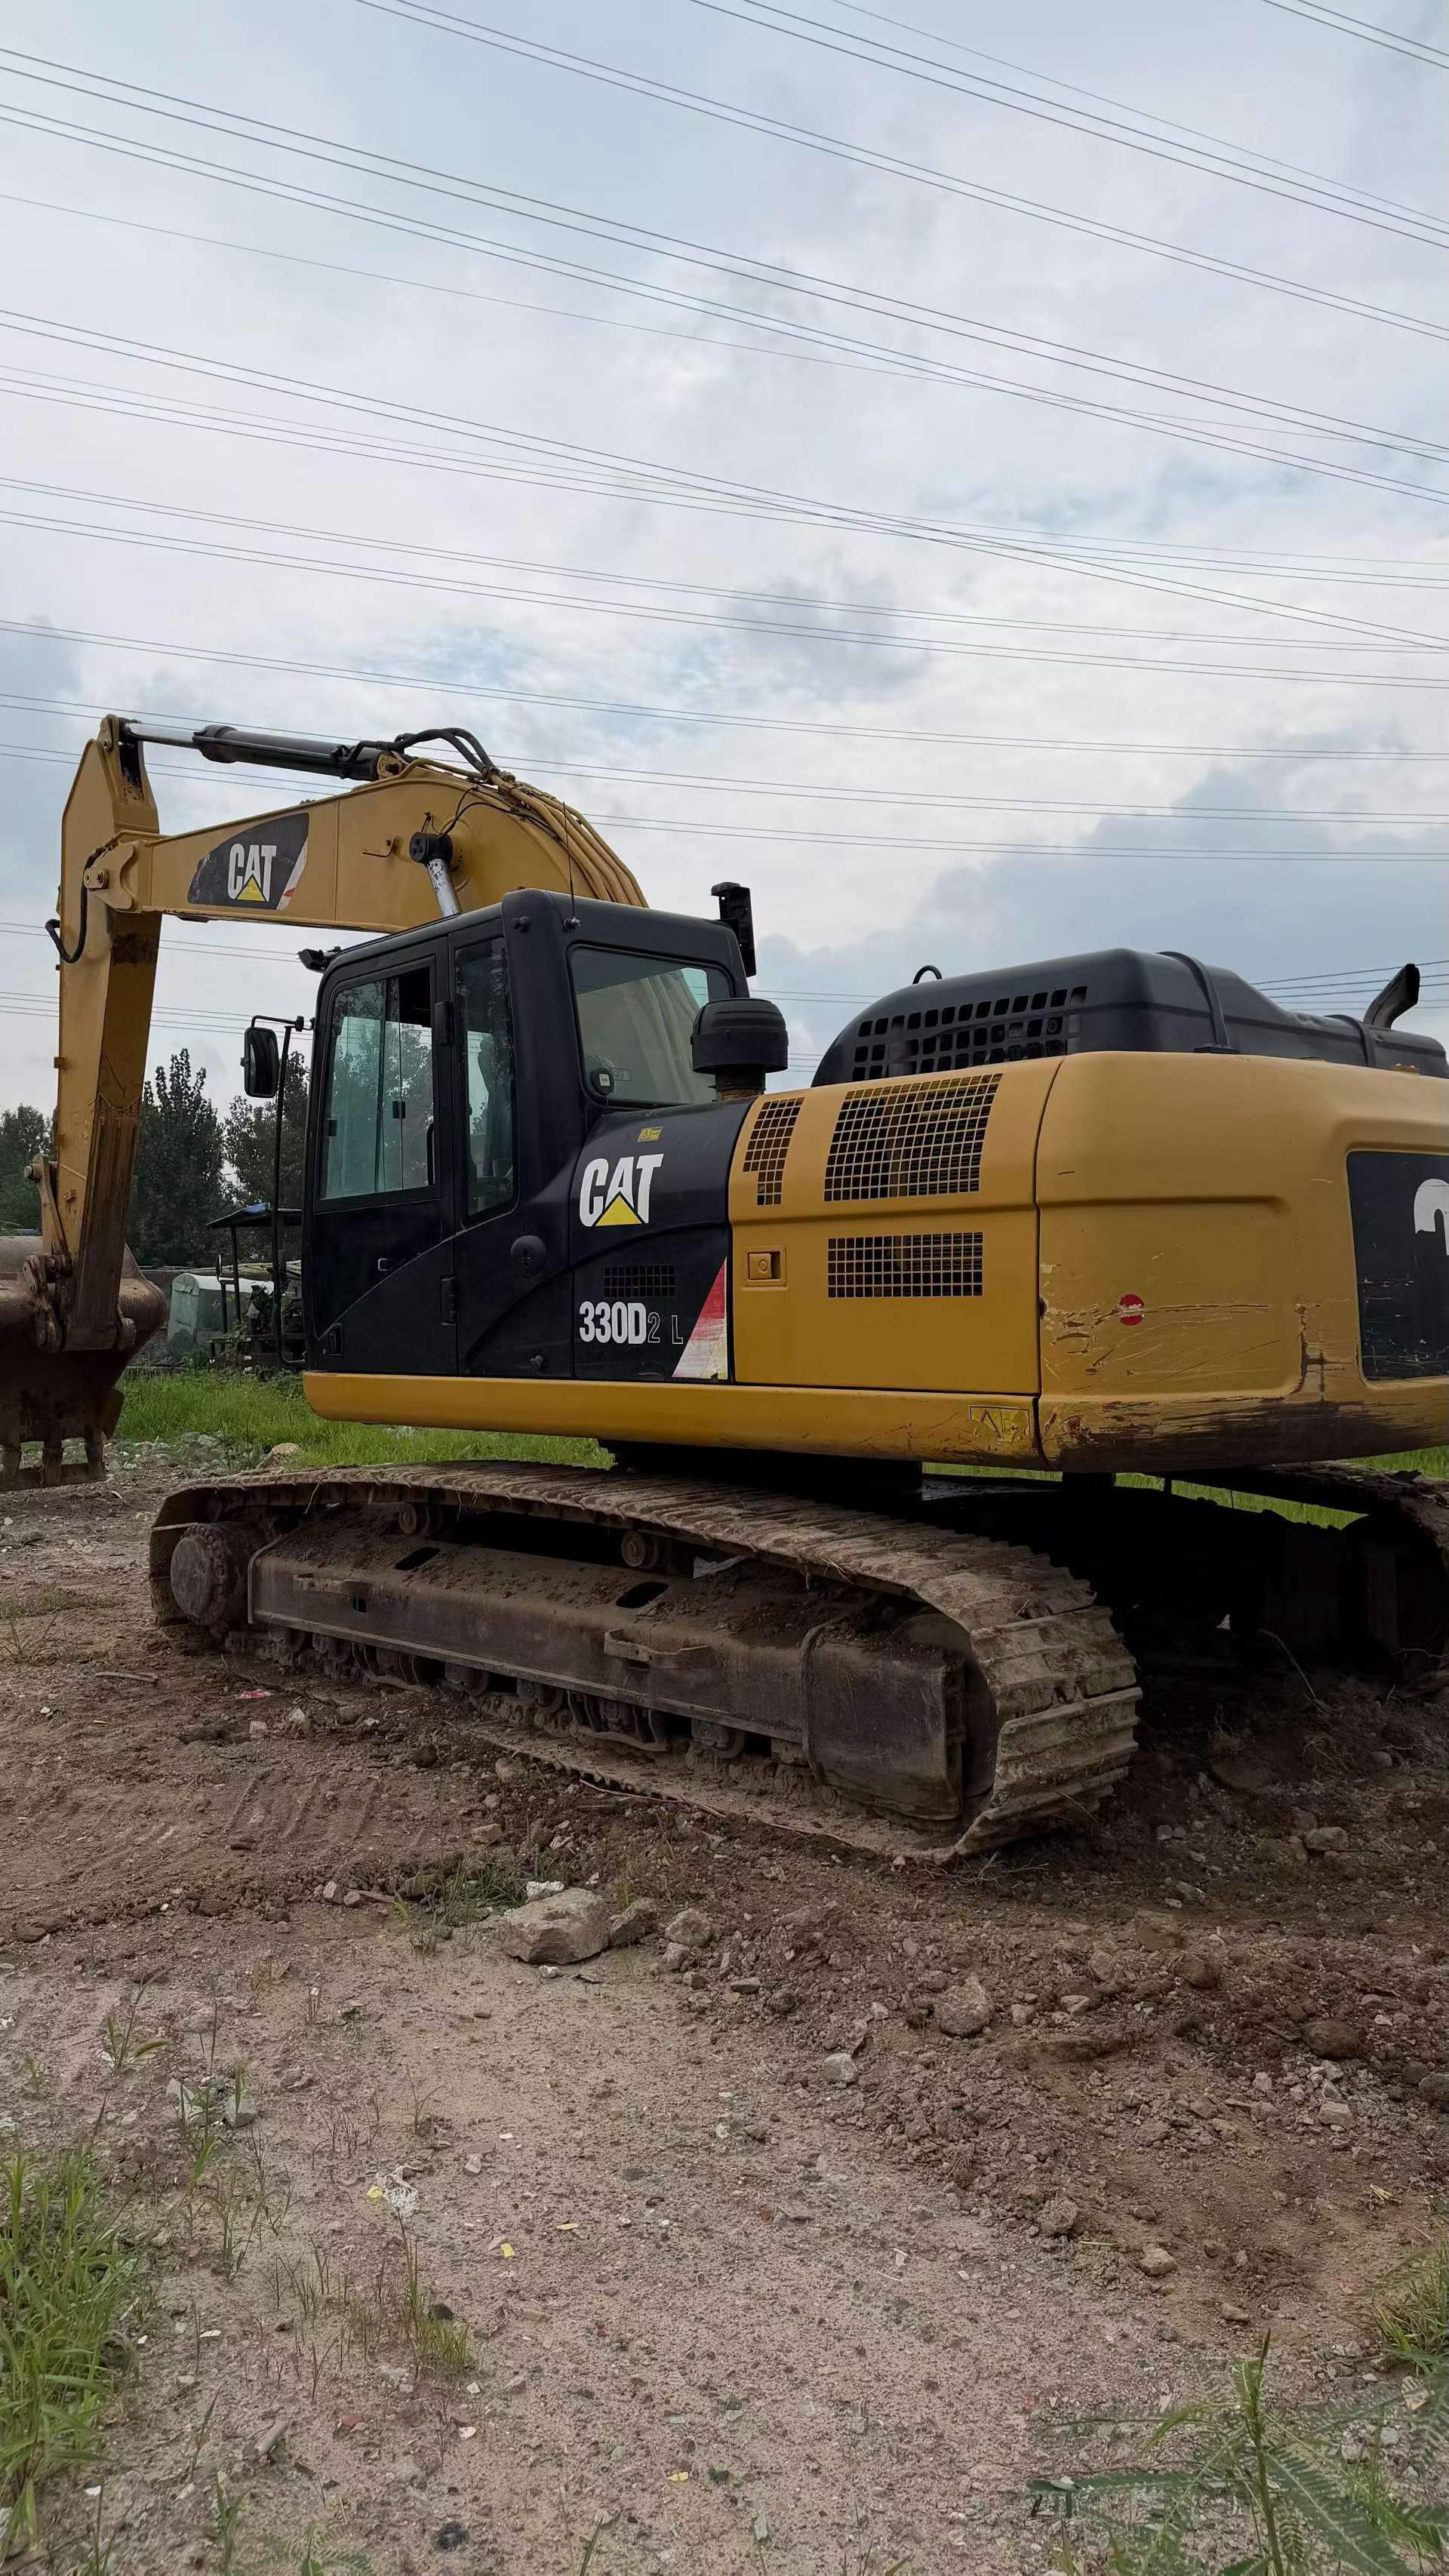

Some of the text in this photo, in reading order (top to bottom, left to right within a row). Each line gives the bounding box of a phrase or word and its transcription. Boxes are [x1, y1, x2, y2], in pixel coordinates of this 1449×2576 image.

[228, 843, 277, 902] CAT
[580, 1153, 664, 1227] CAT
[672, 1315, 684, 1345] L
